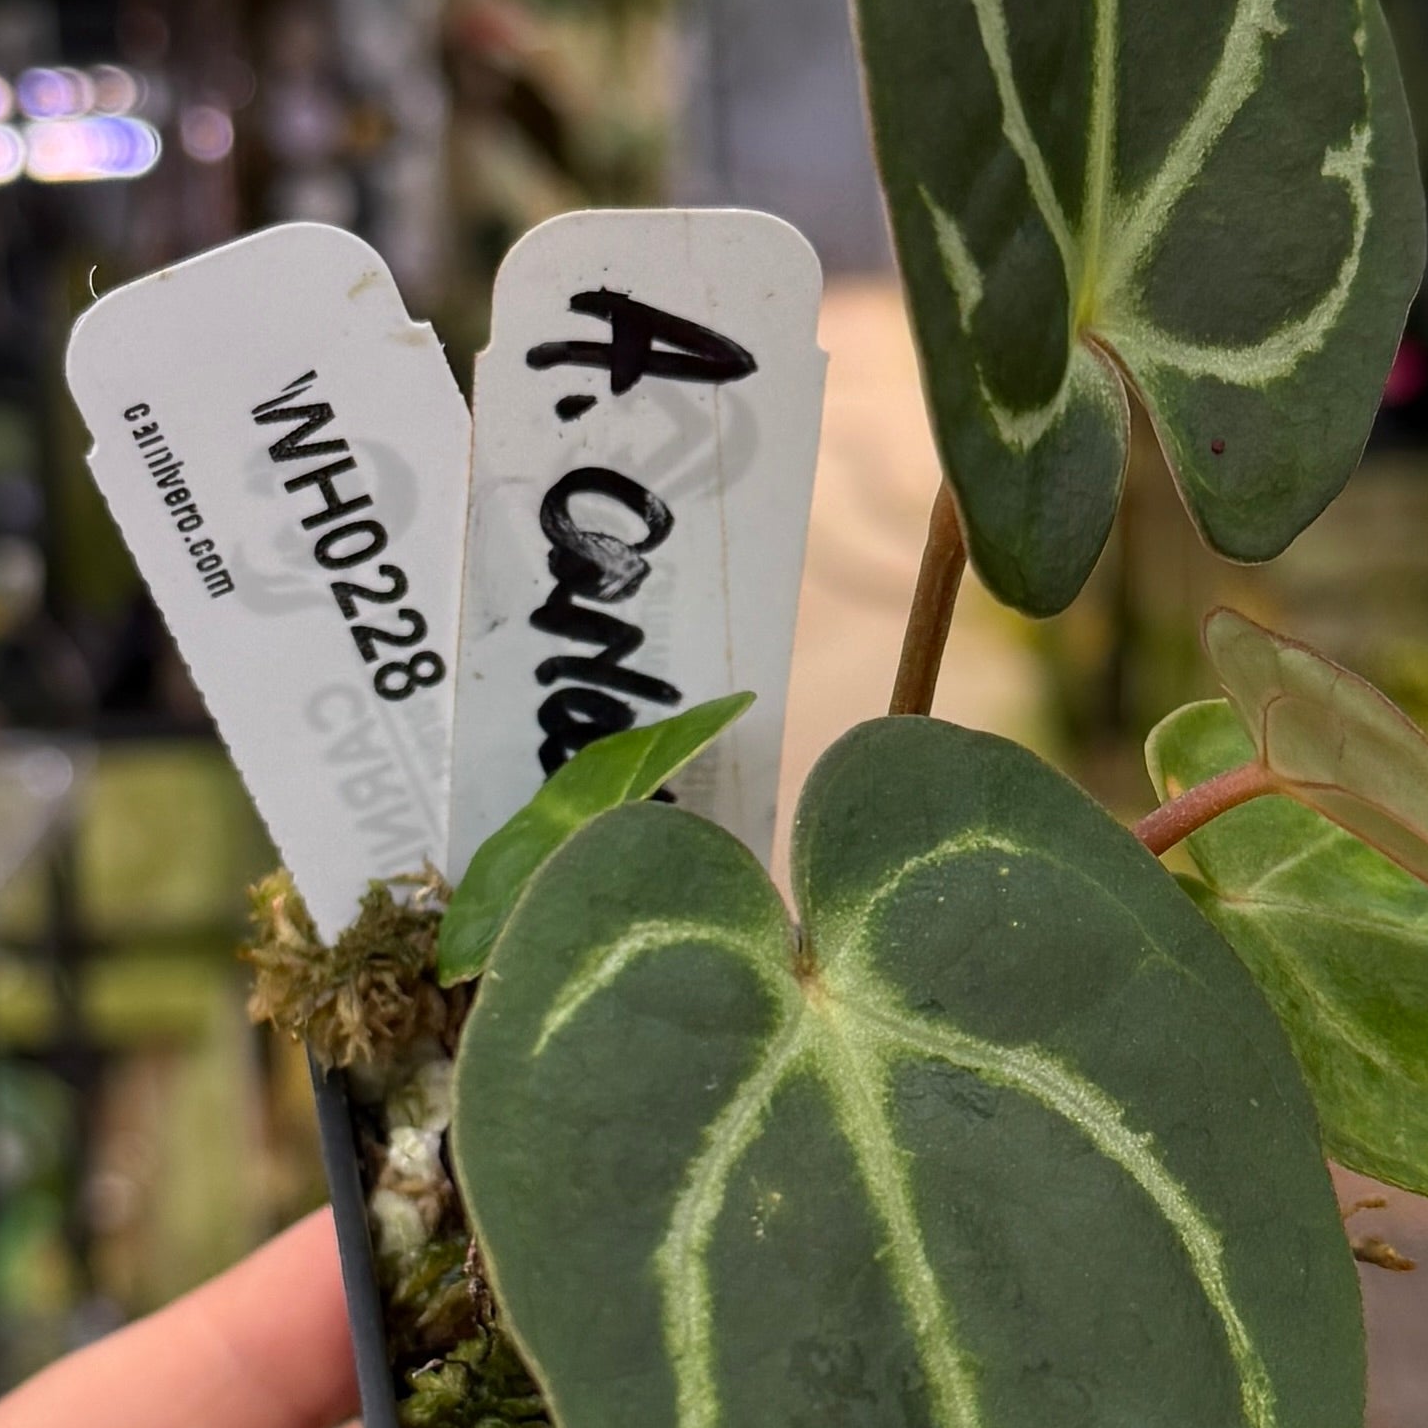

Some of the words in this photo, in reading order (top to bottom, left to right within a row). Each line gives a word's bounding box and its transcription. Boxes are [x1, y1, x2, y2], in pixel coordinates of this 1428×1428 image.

[526, 288, 758, 422] A.
[123, 402, 235, 599] carnivero.com
[251, 369, 446, 702] WH0228
